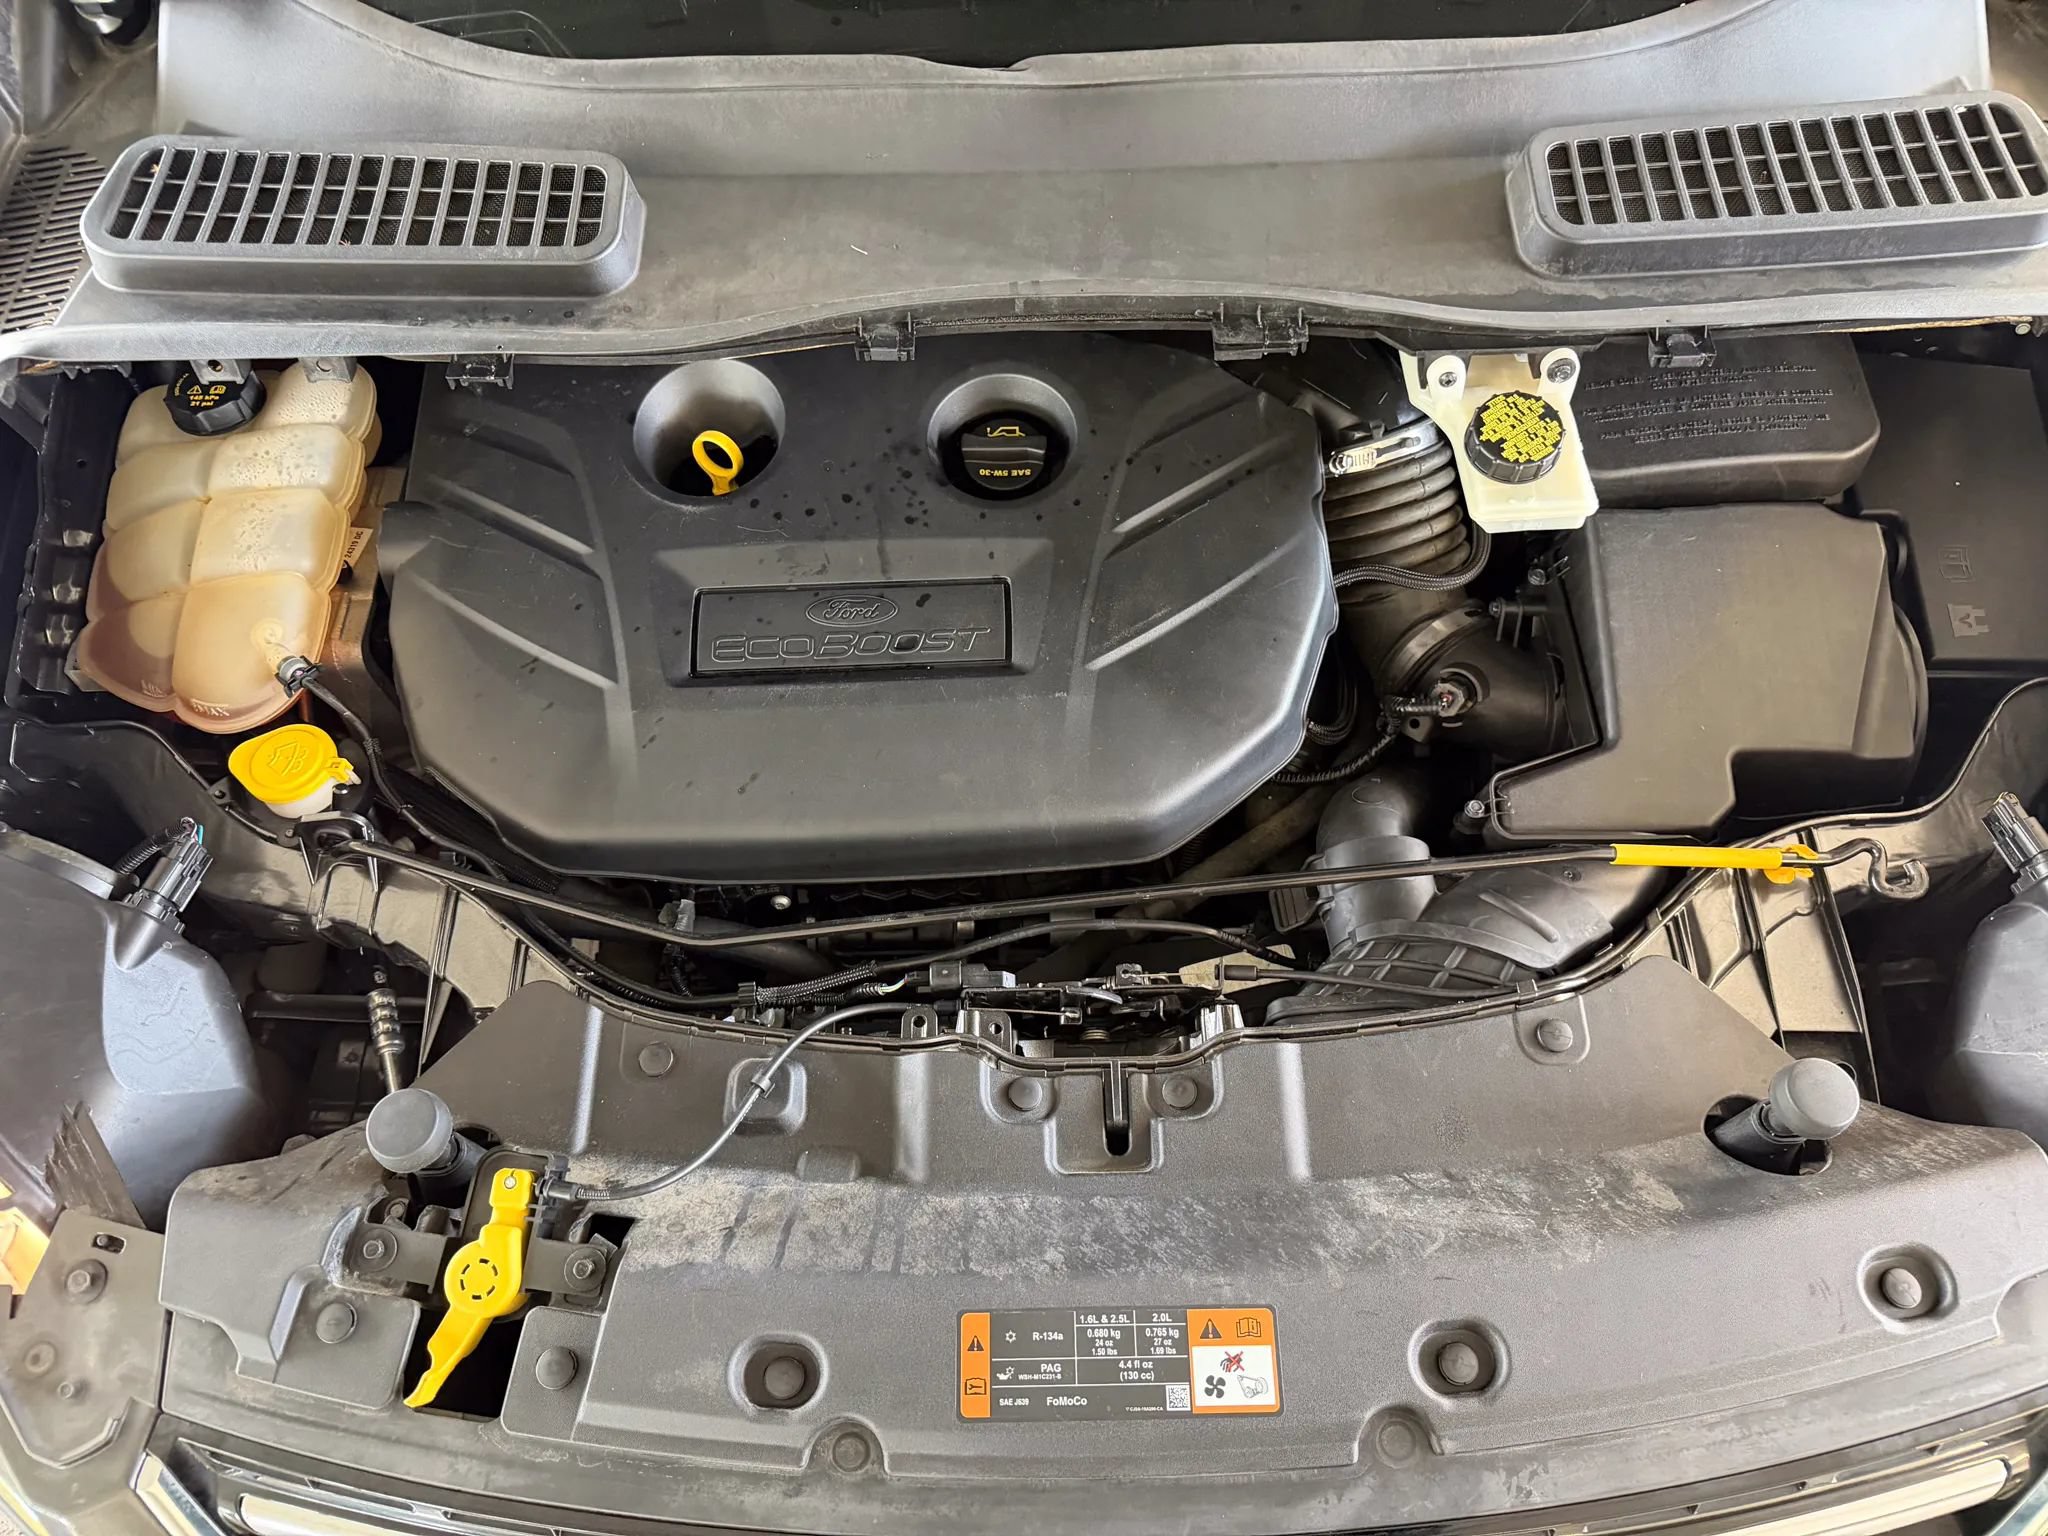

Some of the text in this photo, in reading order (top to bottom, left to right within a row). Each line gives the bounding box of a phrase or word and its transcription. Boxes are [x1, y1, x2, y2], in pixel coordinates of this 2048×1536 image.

[979, 469, 1031, 477] SAE 5W-30
[823, 599, 881, 620] Ford
[1080, 1314, 1130, 1324] 1.6L & 2.5L
[1152, 1312, 1172, 1322] 2.0L
[1032, 1331, 1064, 1341] R-134a
[1087, 1328, 1121, 1339] 0.680 kg
[1145, 1328, 1179, 1338] 0.765 kg
[1091, 1348, 1106, 1356] 1.50
[1040, 1363, 1062, 1373] PAG
[1118, 1360, 1132, 1369] 4.4
[1133, 1360, 1140, 1369] fl
[1119, 1371, 1155, 1381] (130 cc)
[999, 1398, 1013, 1406] SAE
[1046, 1395, 1088, 1407] FoMoCo
